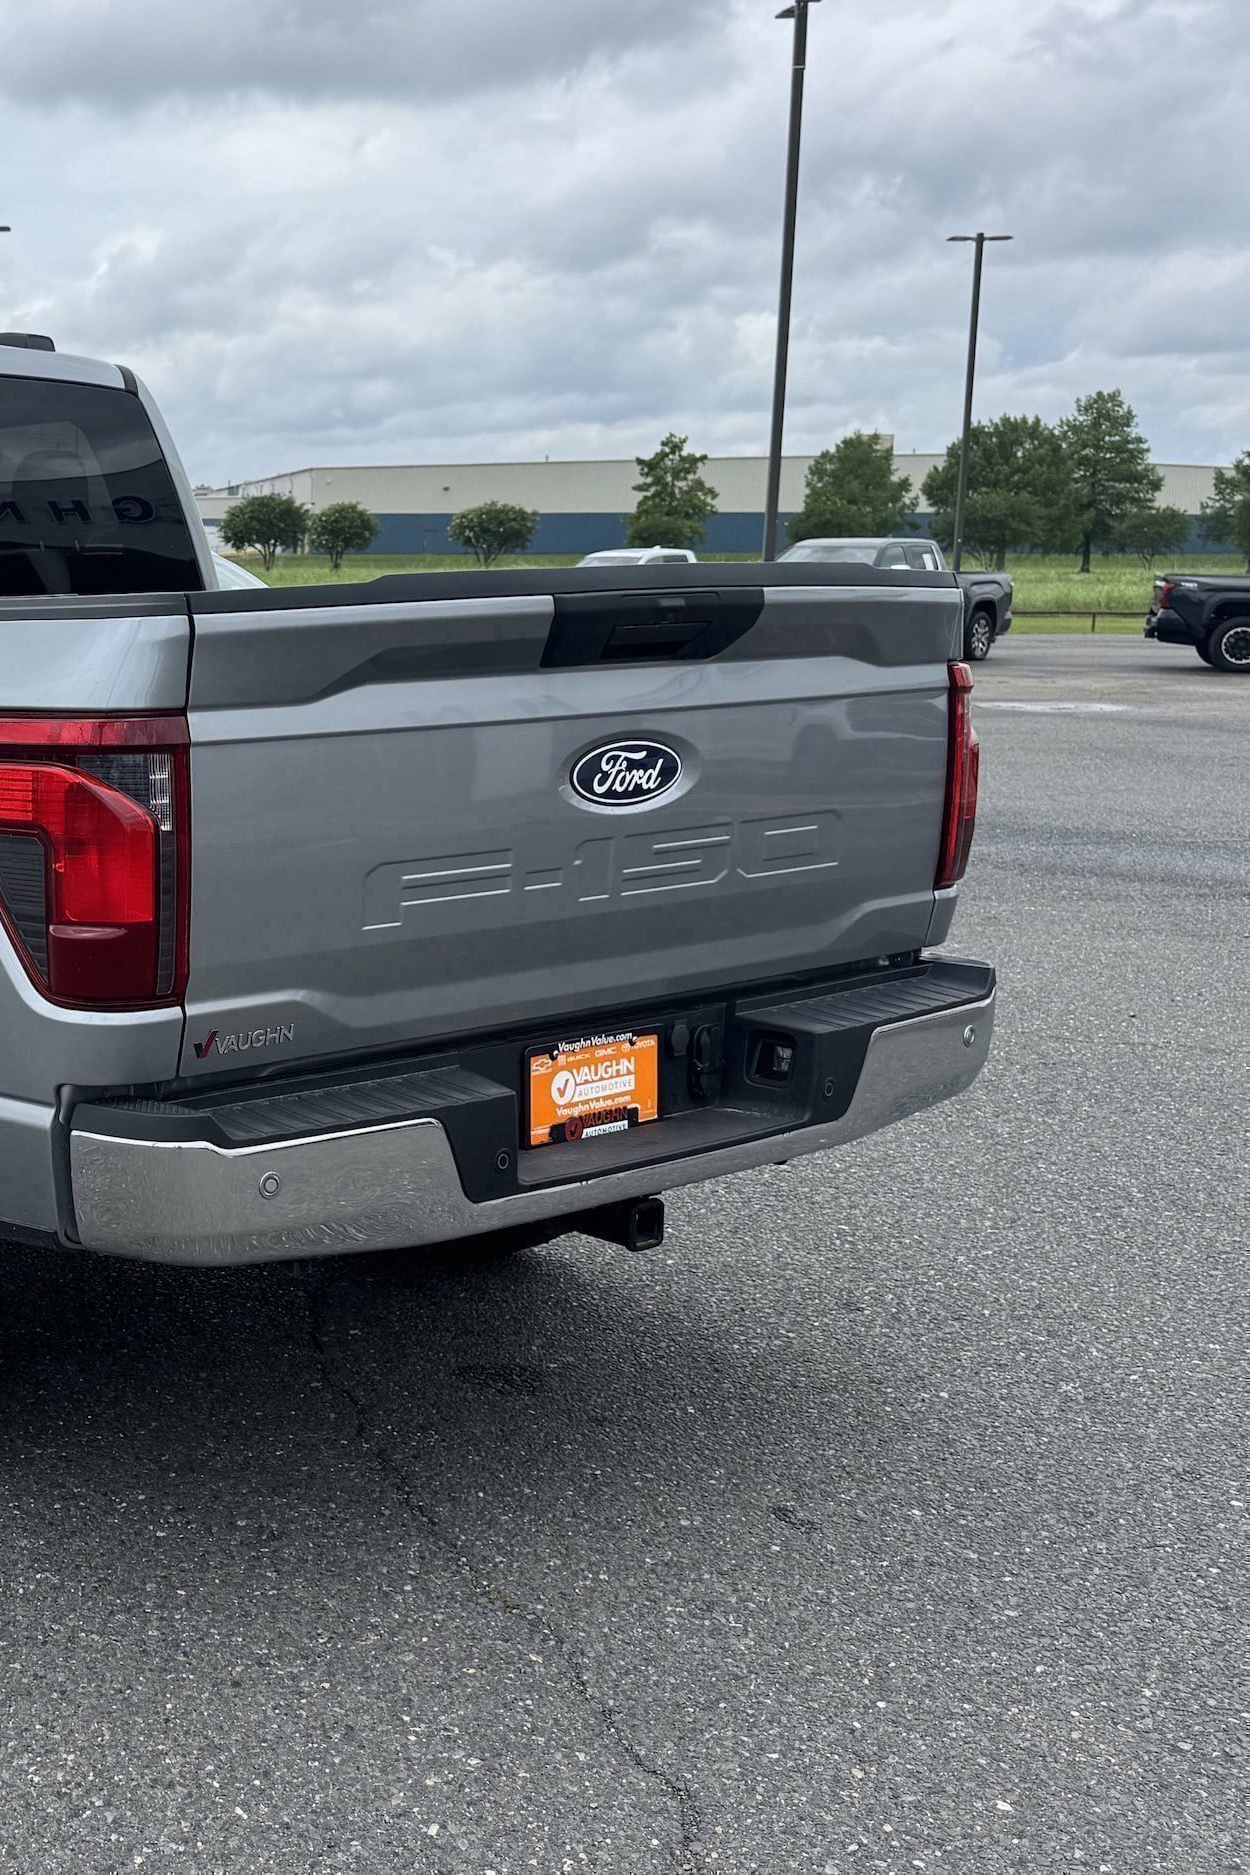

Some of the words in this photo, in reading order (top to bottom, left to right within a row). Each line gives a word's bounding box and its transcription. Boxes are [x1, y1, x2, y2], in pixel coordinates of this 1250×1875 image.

[593, 750, 664, 794] Ford
[362, 809, 844, 930] F-150
[215, 1023, 295, 1055] VAUGHN
[558, 1032, 632, 1052] VaughnValue.com
[631, 1039, 655, 1050] OYOTA
[595, 1047, 617, 1058] GMC
[573, 1057, 635, 1084] VAUGHN
[578, 1077, 633, 1098] AUTOMOTIVE
[556, 1095, 631, 1116] VaughnValue.com
[579, 1106, 629, 1128] VAUGHN
[585, 1124, 627, 1137] AUTOMOTIVE
